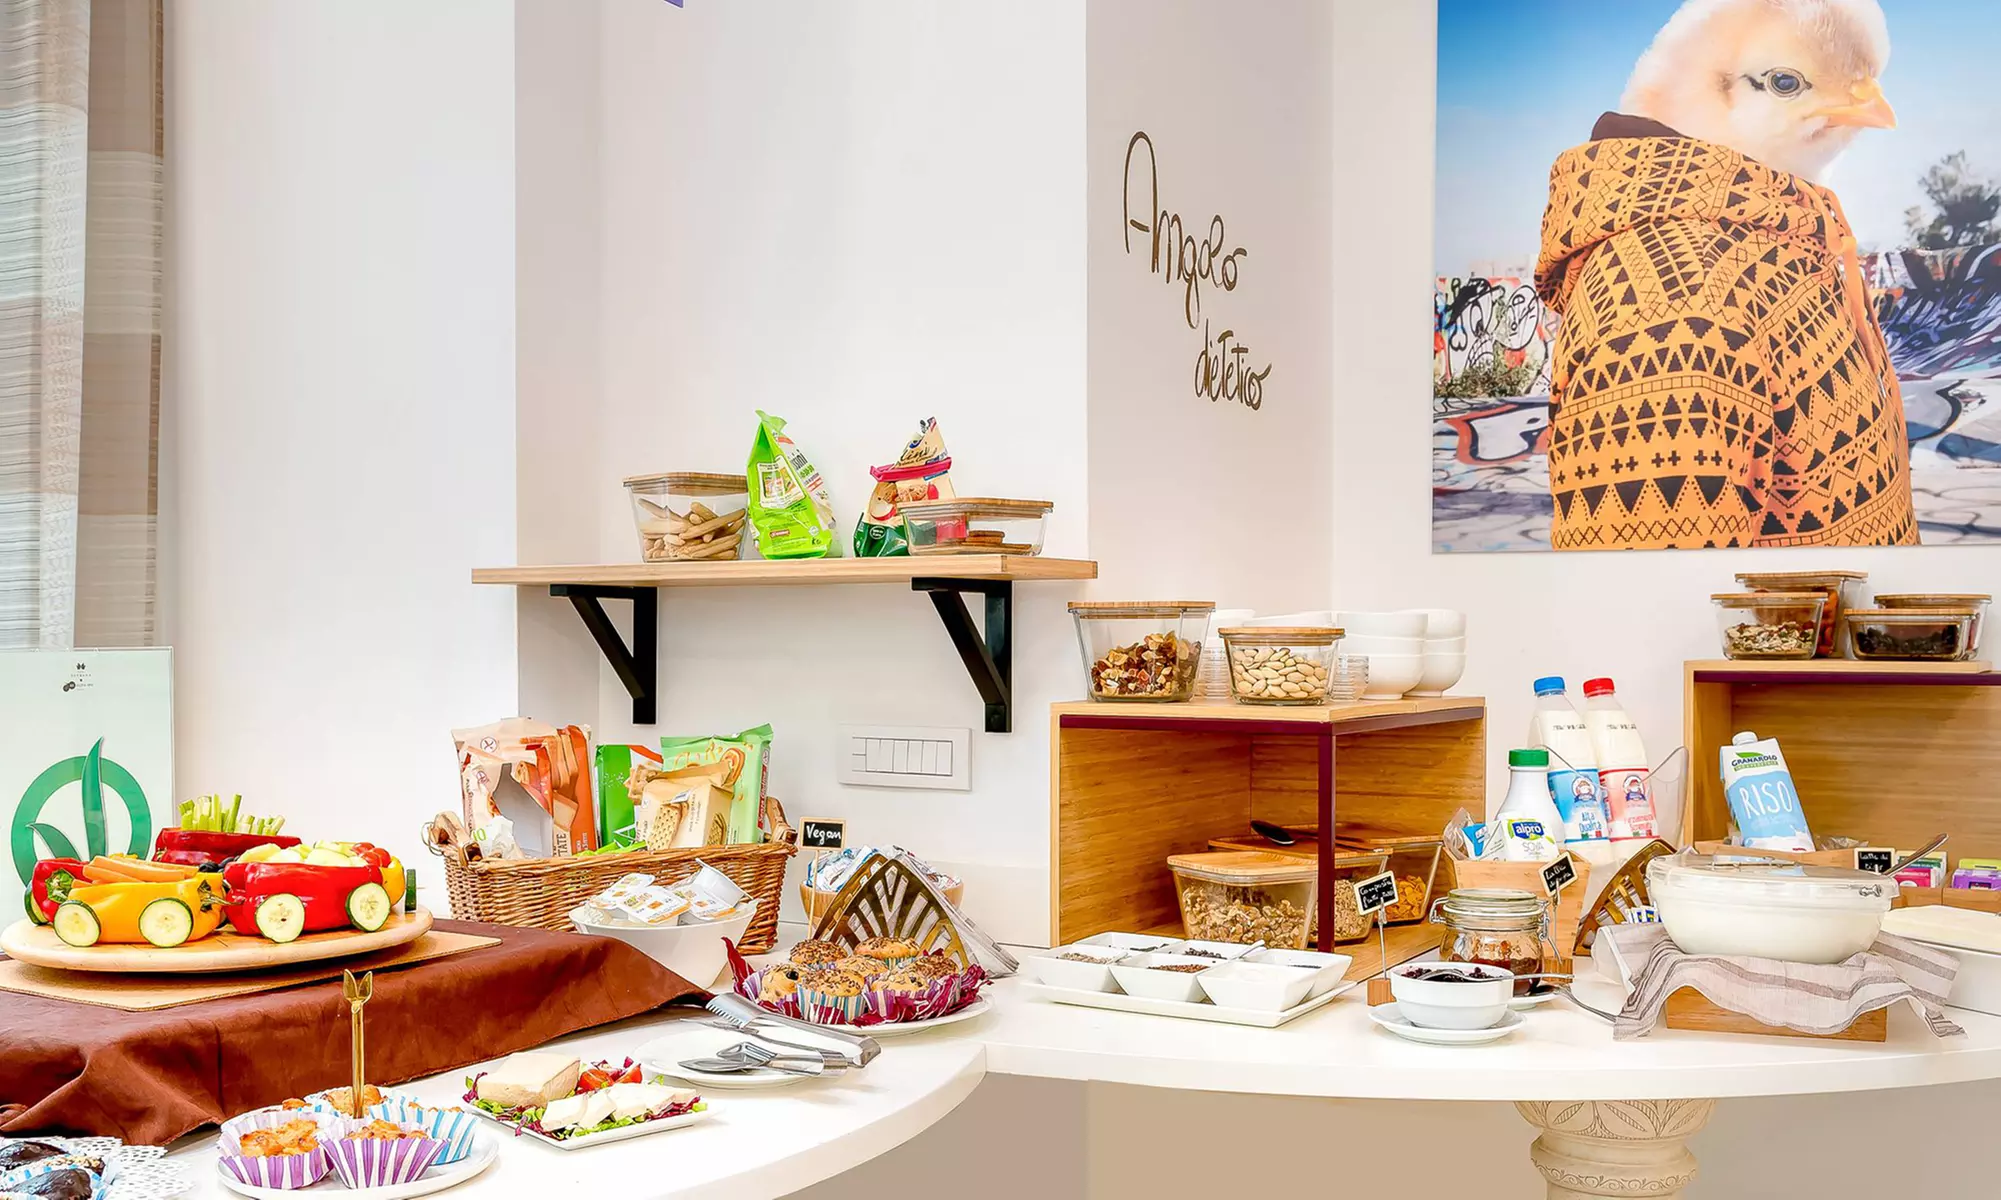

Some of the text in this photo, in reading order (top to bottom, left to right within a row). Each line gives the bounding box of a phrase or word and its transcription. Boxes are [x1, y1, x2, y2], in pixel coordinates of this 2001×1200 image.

[1123, 131, 1247, 329] Angolo
[1739, 780, 1793, 819] RISO
[806, 823, 842, 845] Vegan
[1515, 822, 1542, 836] alpro
